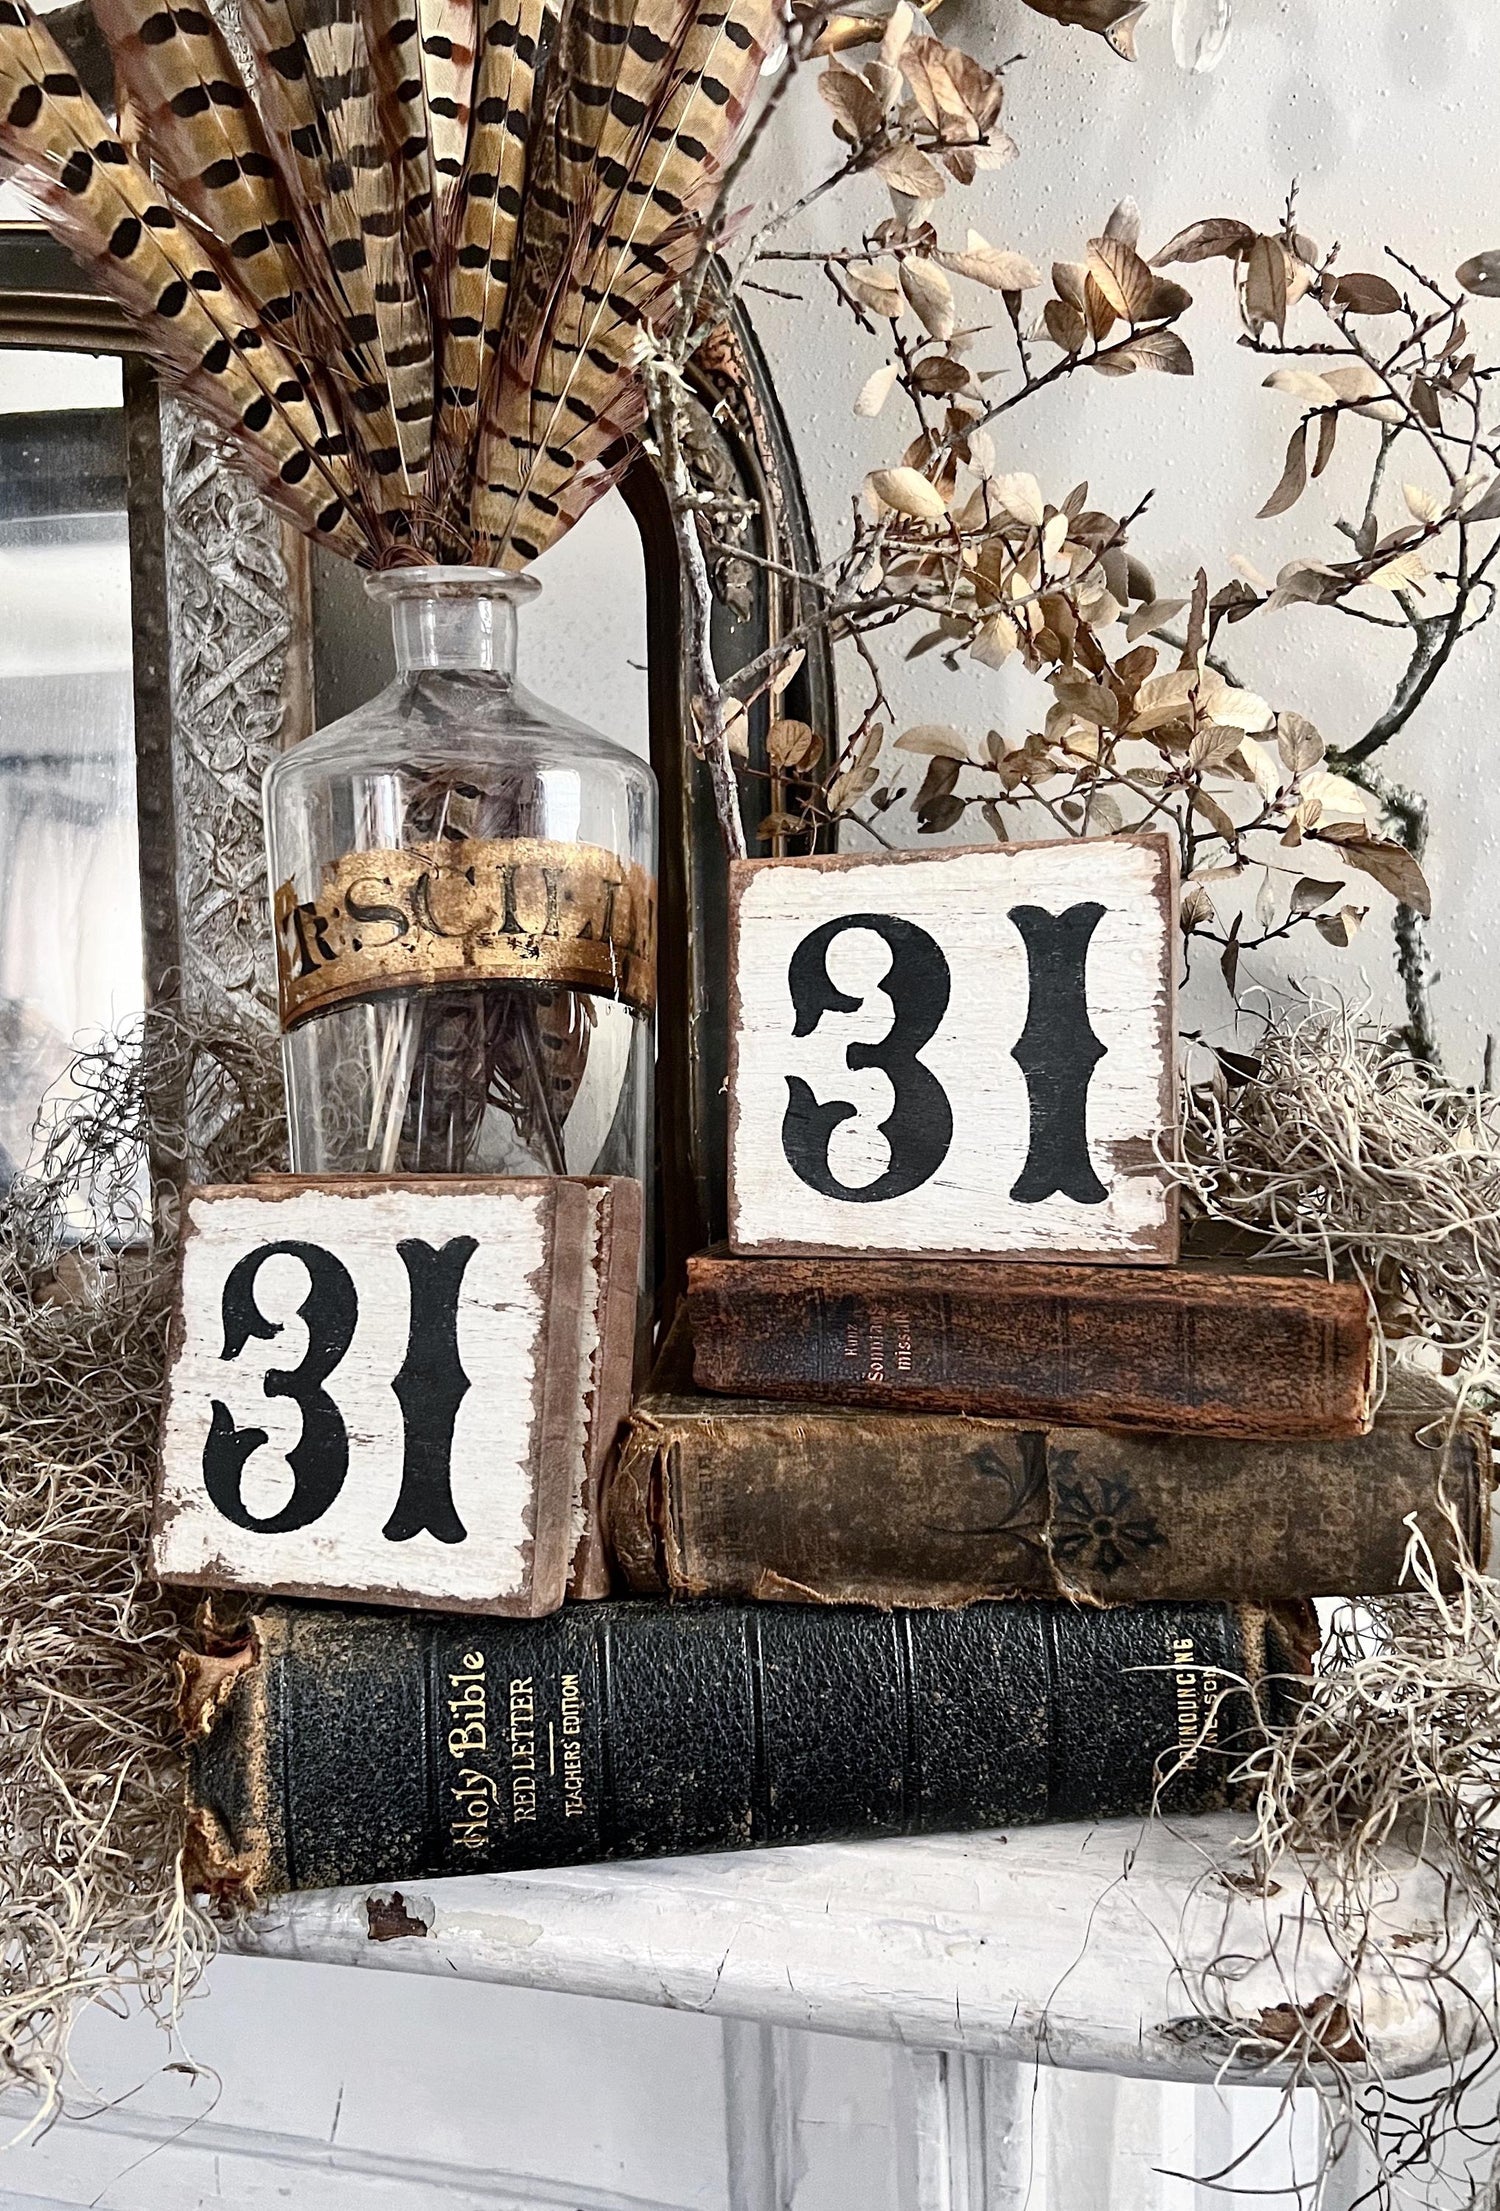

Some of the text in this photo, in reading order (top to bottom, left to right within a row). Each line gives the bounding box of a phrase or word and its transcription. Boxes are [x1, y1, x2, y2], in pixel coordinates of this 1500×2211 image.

[782, 900, 1109, 1204] 31
[202, 1235, 480, 1544] 31
[448, 1651, 499, 1849] Holy Bible
[509, 1676, 536, 1822] RED LETTER
[560, 1674, 582, 1735] EDITION
[1172, 1638, 1198, 1770] PRONOUNCNG
